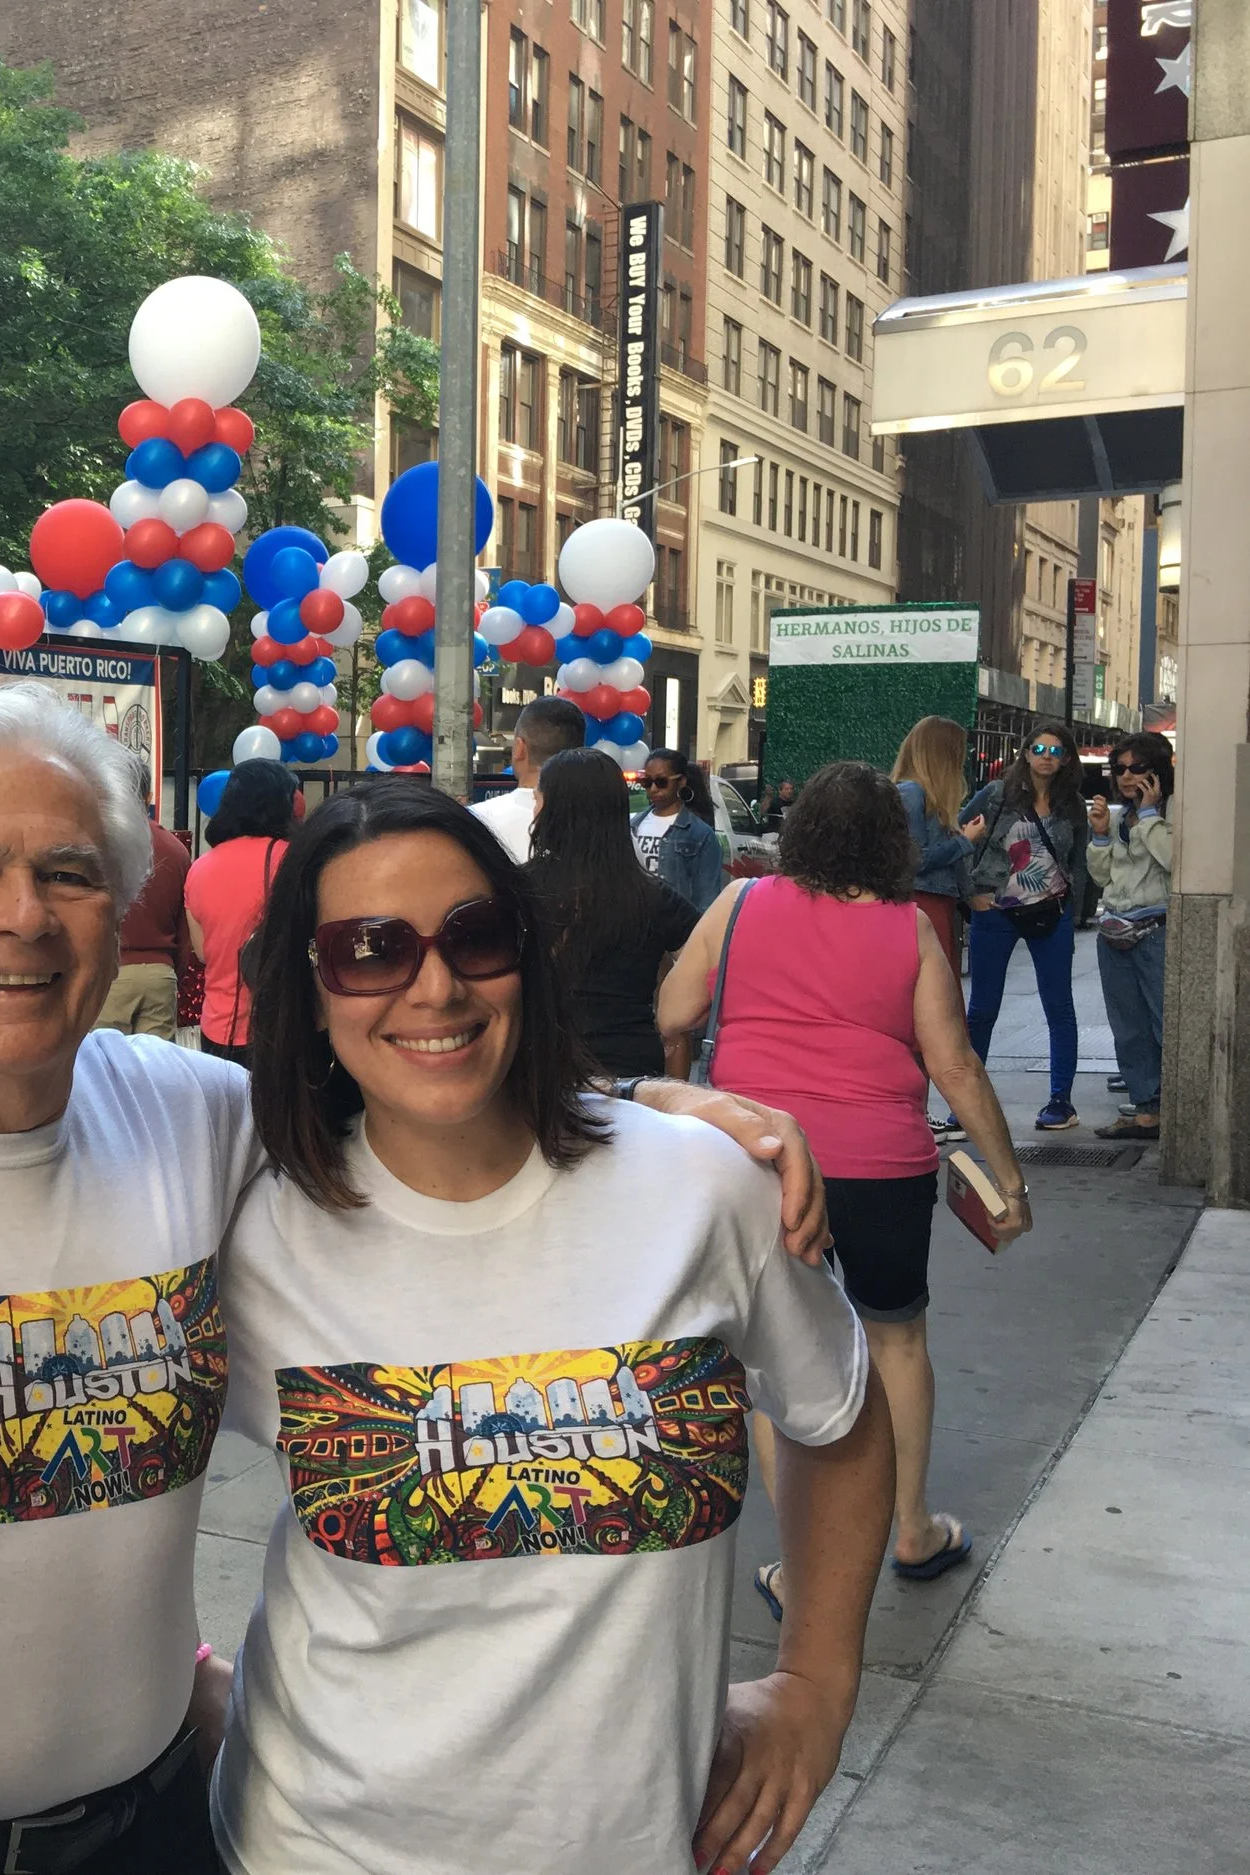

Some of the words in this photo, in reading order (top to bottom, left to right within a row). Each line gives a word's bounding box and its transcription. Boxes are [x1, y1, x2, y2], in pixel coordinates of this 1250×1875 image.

[629, 215, 647, 247] We
[628, 252, 647, 287] BUY
[627, 293, 646, 336] Your
[987, 325, 1088, 397] 62
[776, 620, 885, 638] HERMANOS,
[890, 618, 942, 636] HIJOS
[947, 618, 972, 633] DE
[3, 649, 37, 672] VIVA
[39, 653, 93, 678] PUERTO
[96, 660, 132, 681] RICO!
[832, 643, 910, 659] SALINAS
[62, 1408, 128, 1426] LATINO
[39, 1426, 137, 1485] ART
[415, 1418, 663, 1475] HOUSTON
[73, 1471, 131, 1511] NOW!
[506, 1465, 581, 1486] LATINO
[483, 1482, 593, 1534] ART
[520, 1527, 586, 1555] NOW!
